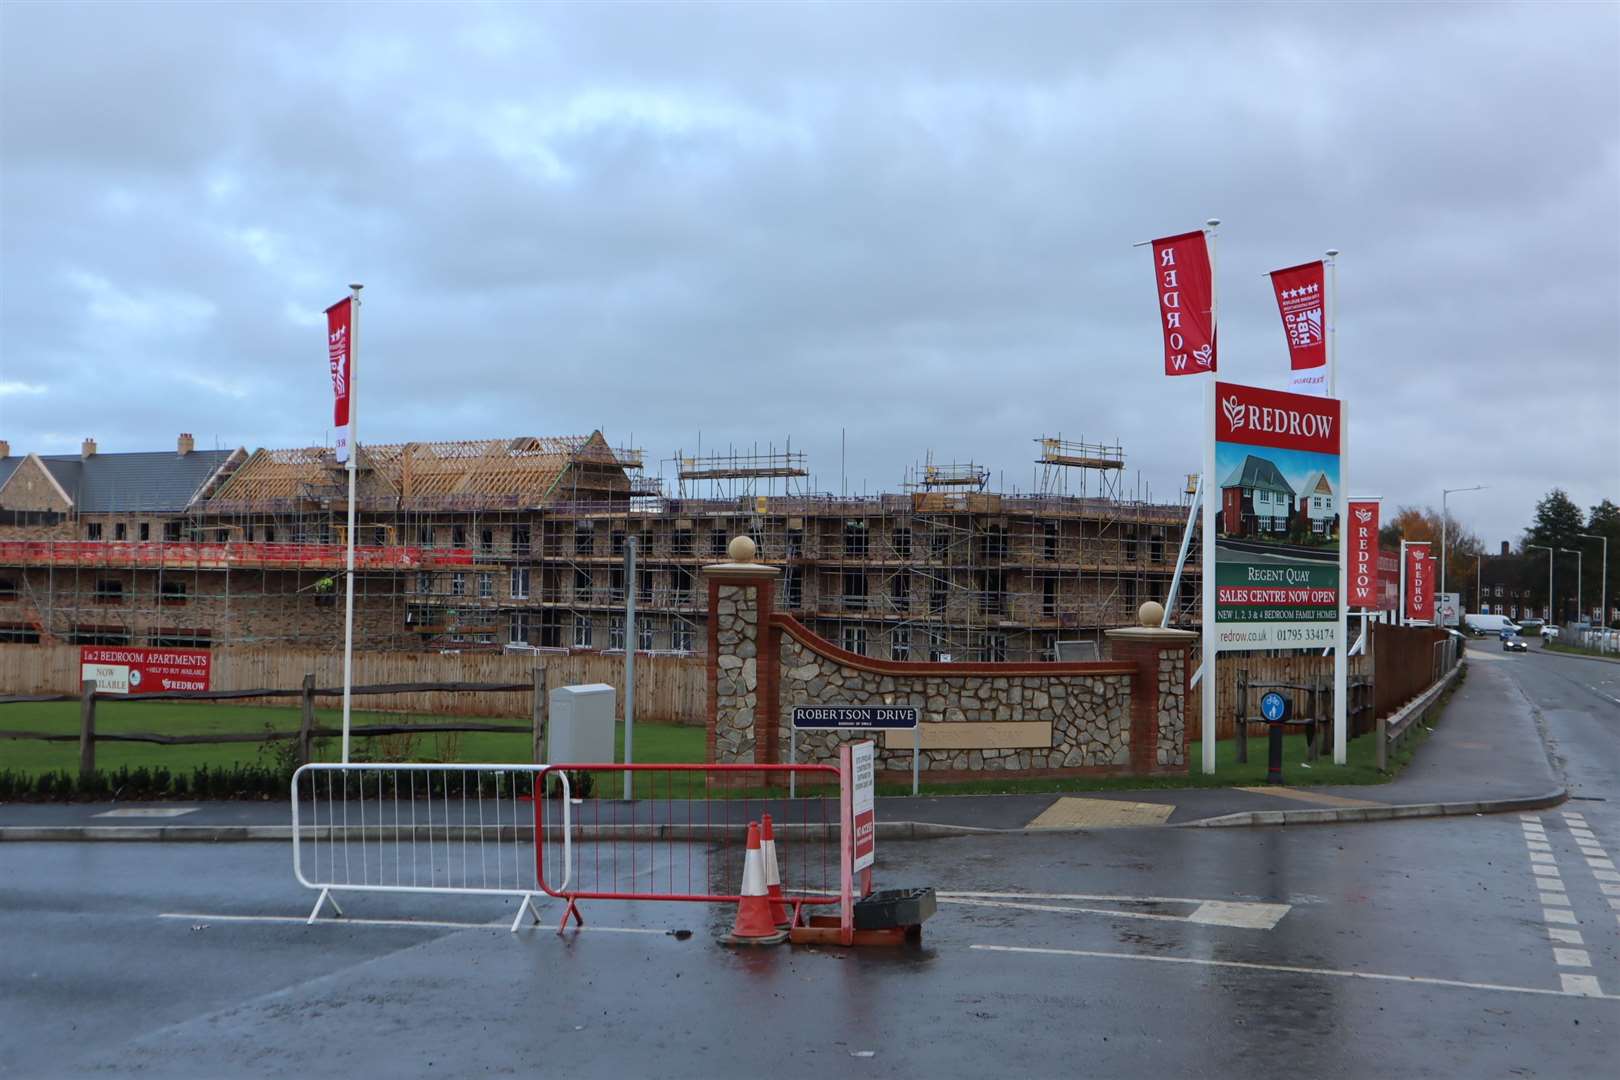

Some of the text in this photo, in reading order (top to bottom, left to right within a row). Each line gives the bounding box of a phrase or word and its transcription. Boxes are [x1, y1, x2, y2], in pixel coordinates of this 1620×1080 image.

[1248, 405, 1333, 439] REDROW
[1356, 527, 1369, 598] REDROW
[1248, 567, 1310, 584] REGENT QUAY
[1413, 562, 1423, 611] REDROW
[1220, 589, 1335, 603] SALES CENTRE NOW OPEN
[1217, 610, 1233, 619] NEW
[1264, 610, 1295, 619] BEDROOM
[1295, 610, 1316, 619] FAMILY
[1316, 610, 1336, 619] HOMES
[1220, 630, 1267, 642] redrow.co.uk
[1277, 629, 1334, 641] 01795 334174
[100, 651, 143, 663] BEDROOM
[147, 653, 207, 666] APARTMENTS
[171, 680, 205, 690] REDROW
[797, 709, 914, 720] ROBERTSON DRIVE
